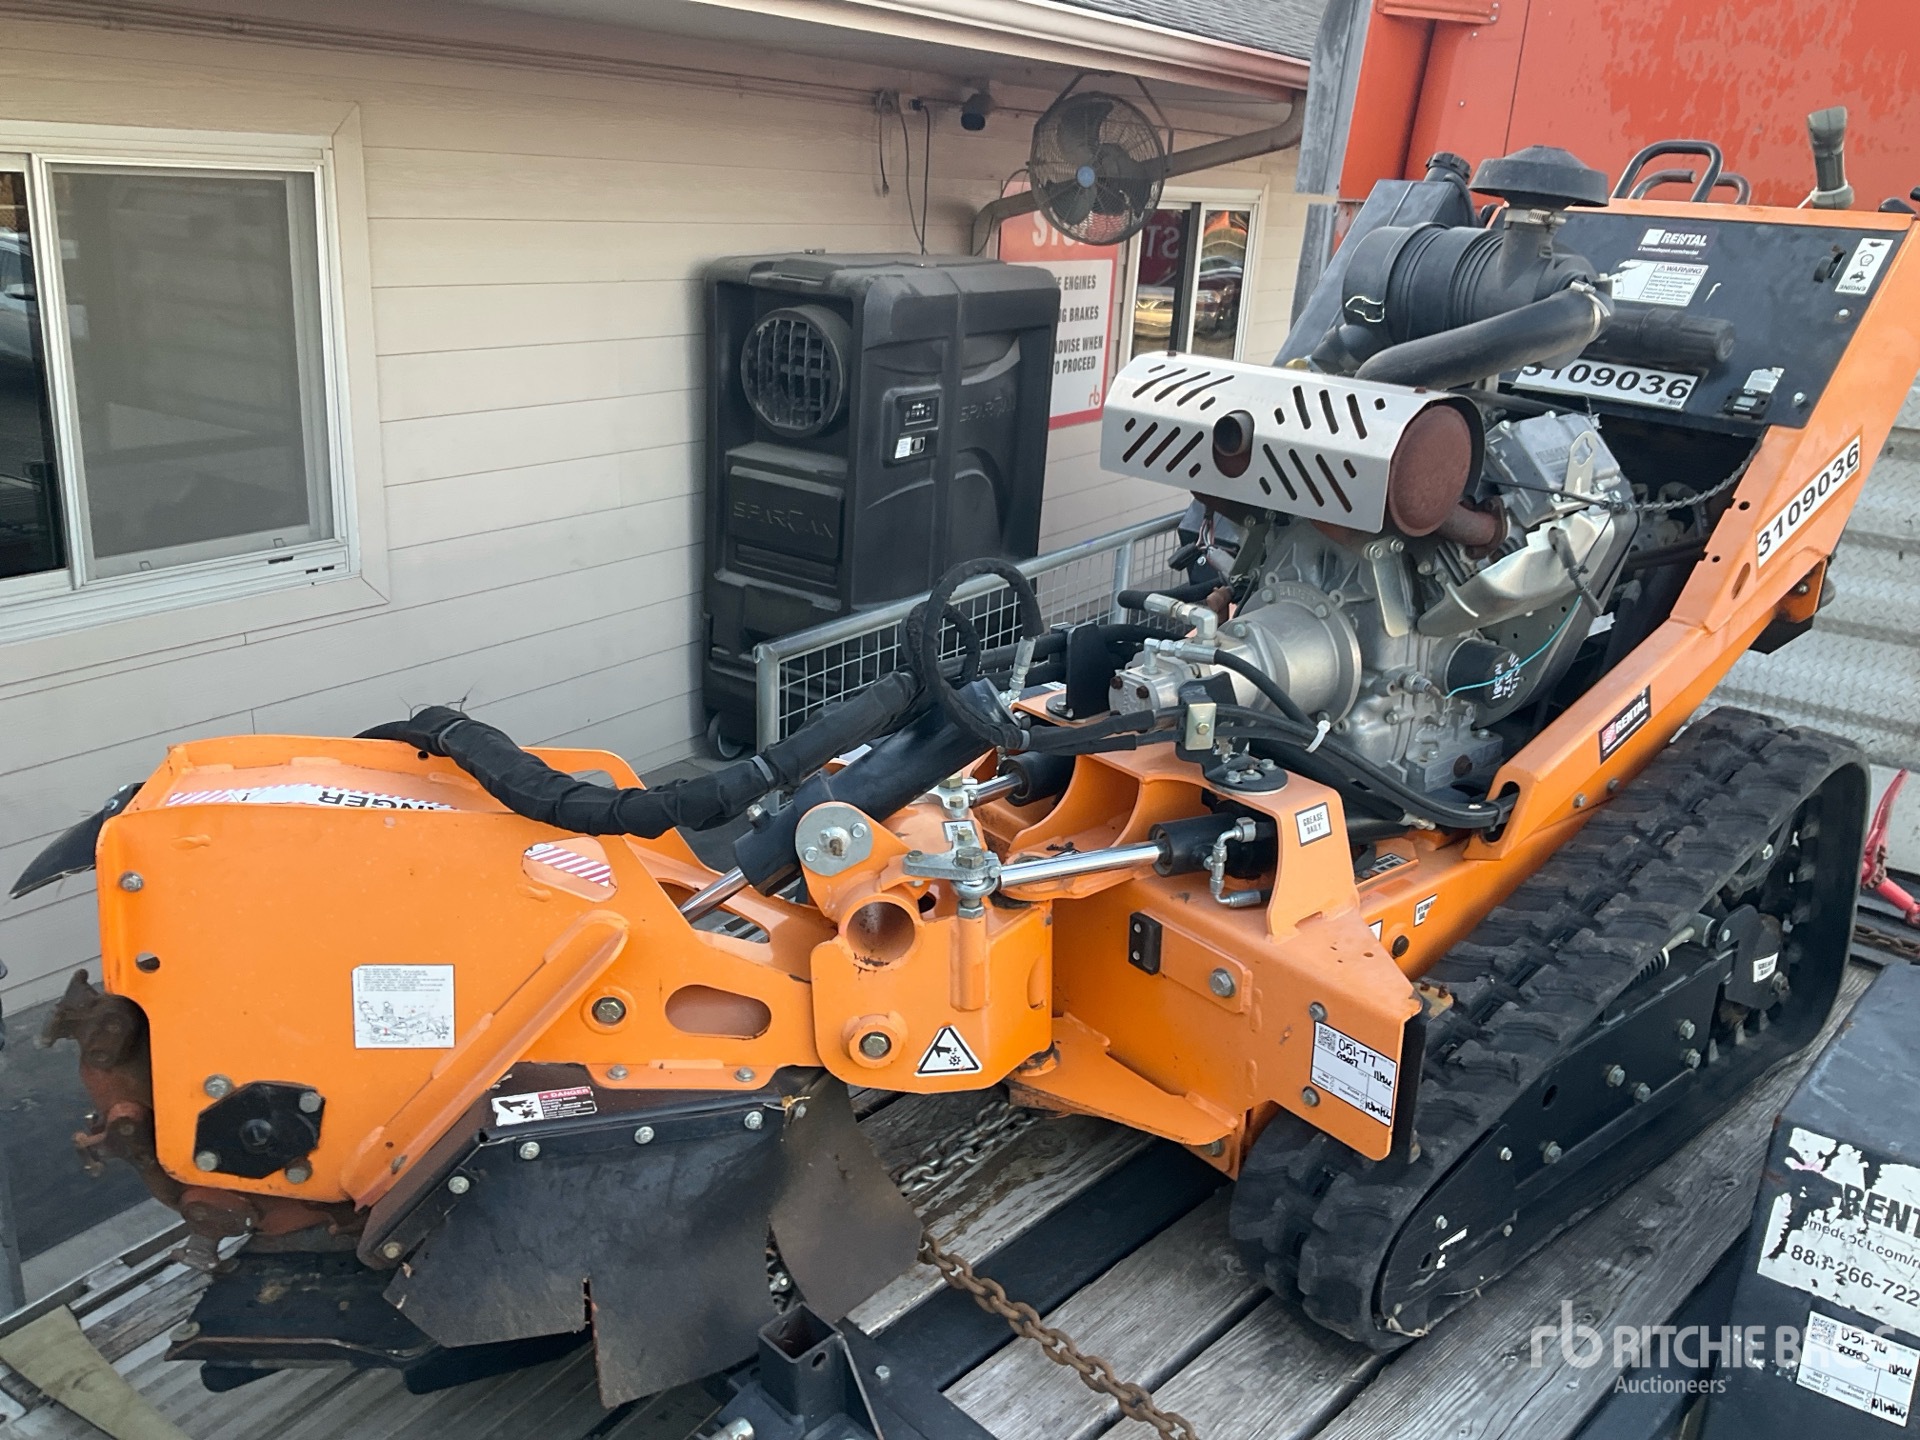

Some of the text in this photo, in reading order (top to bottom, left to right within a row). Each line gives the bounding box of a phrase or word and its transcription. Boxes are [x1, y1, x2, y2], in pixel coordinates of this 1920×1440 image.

[1660, 232, 1708, 247] RENTAL
[1666, 265, 1703, 275] WARNING
[1063, 275, 1097, 291] ENGINES
[1069, 305, 1099, 322] BRAKES
[1082, 335, 1104, 351] WHEN
[1062, 356, 1096, 374] PROCEED
[1757, 442, 1859, 557] 3109036
[1302, 811, 1324, 827] GREASE
[1306, 822, 1322, 835] DAILY
[550, 1089, 590, 1099] DANGER
